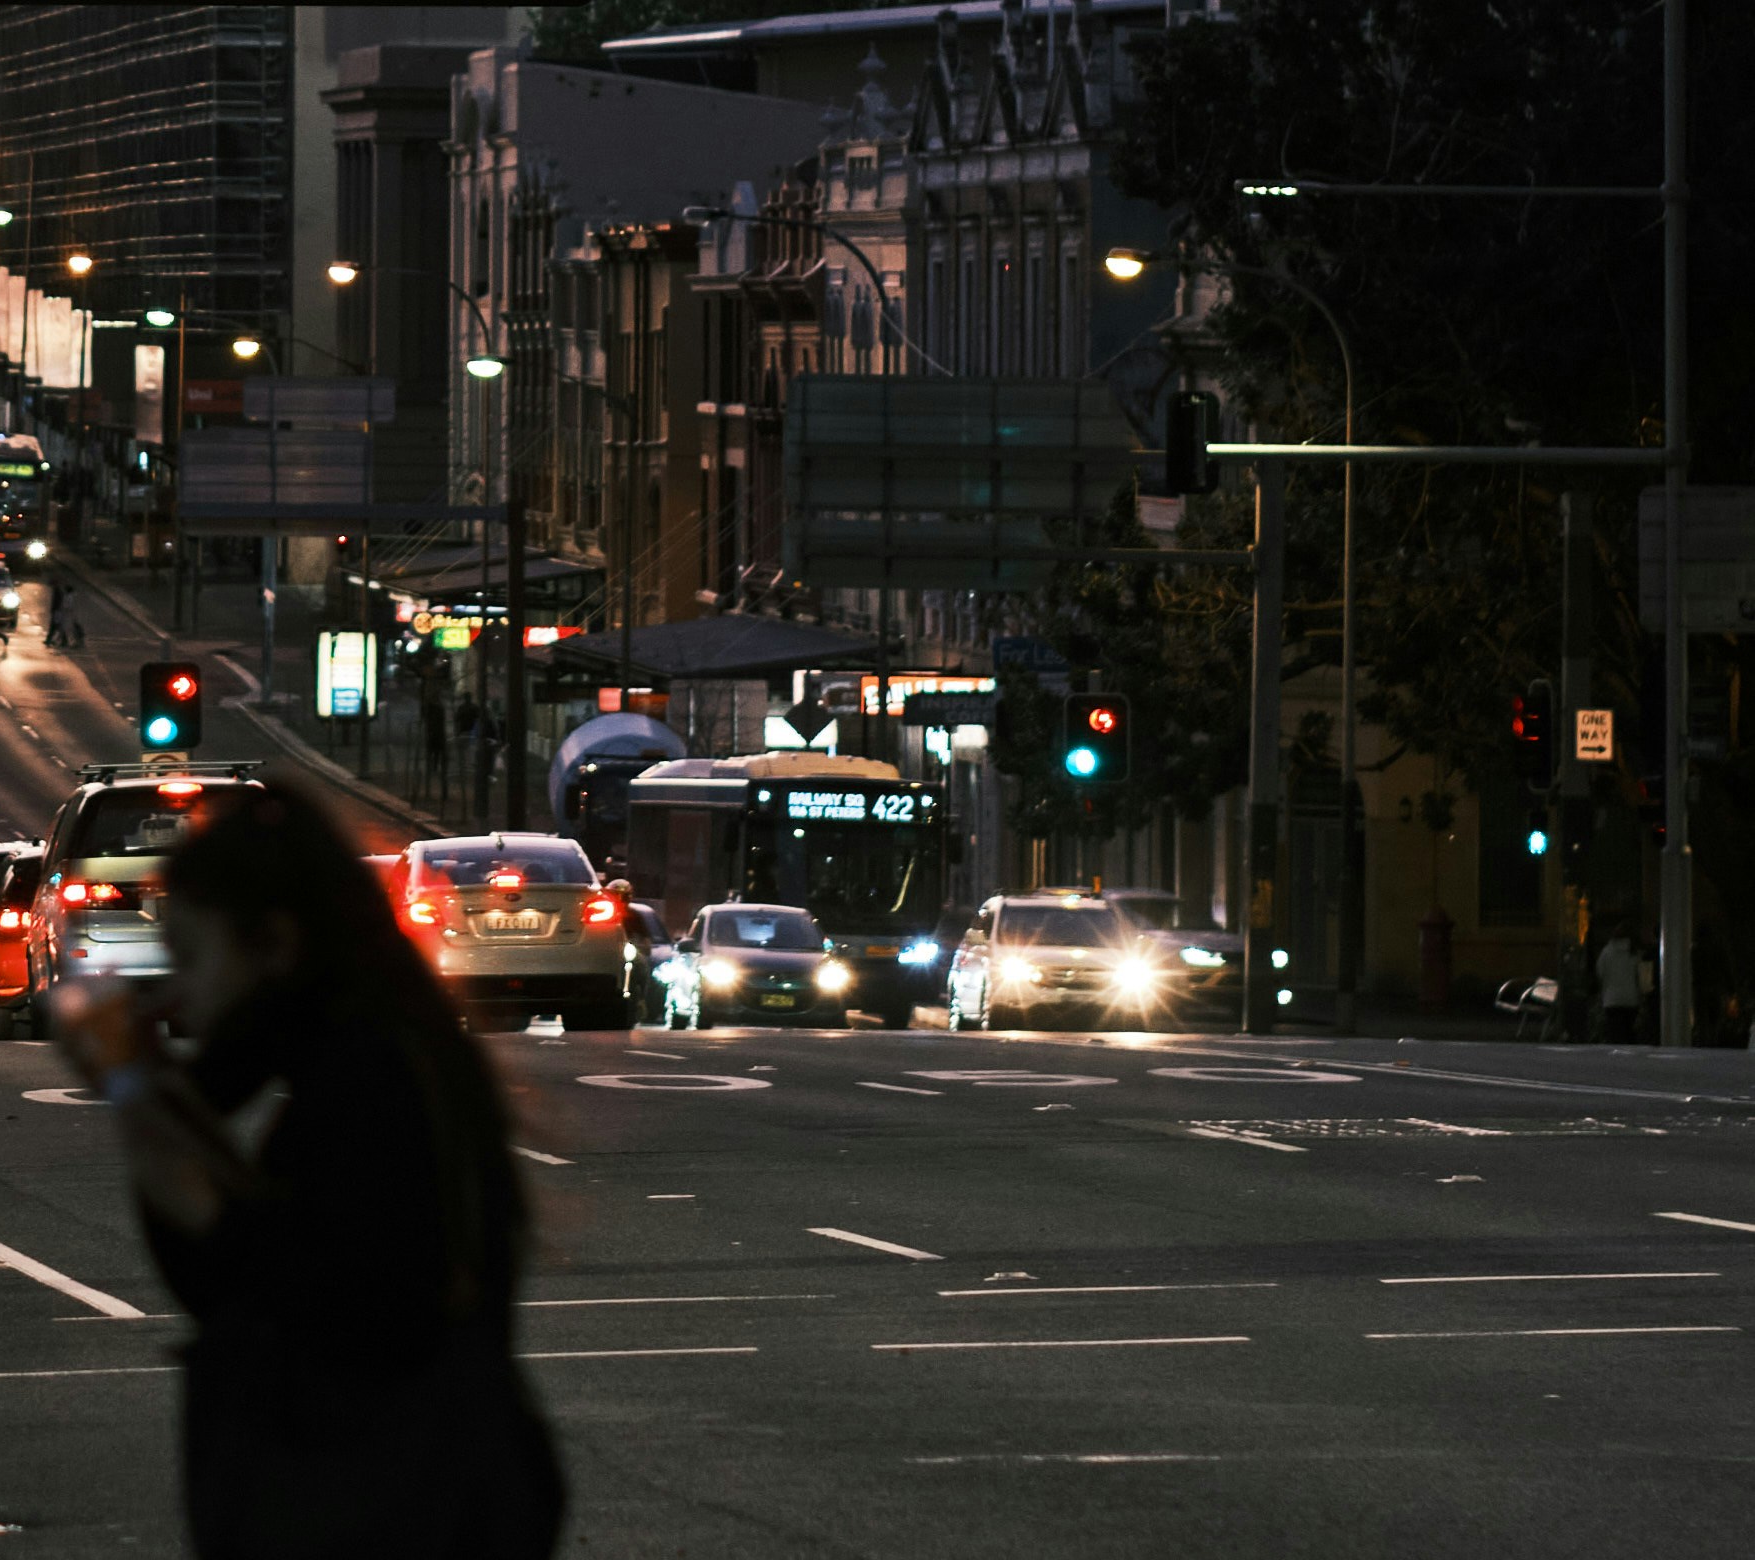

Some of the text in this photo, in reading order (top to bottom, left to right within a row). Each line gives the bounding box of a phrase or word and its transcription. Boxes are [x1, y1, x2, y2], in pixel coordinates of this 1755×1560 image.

[1582, 714, 1606, 725] ONE
[1581, 730, 1608, 740] WAY
[871, 794, 914, 821] 422
